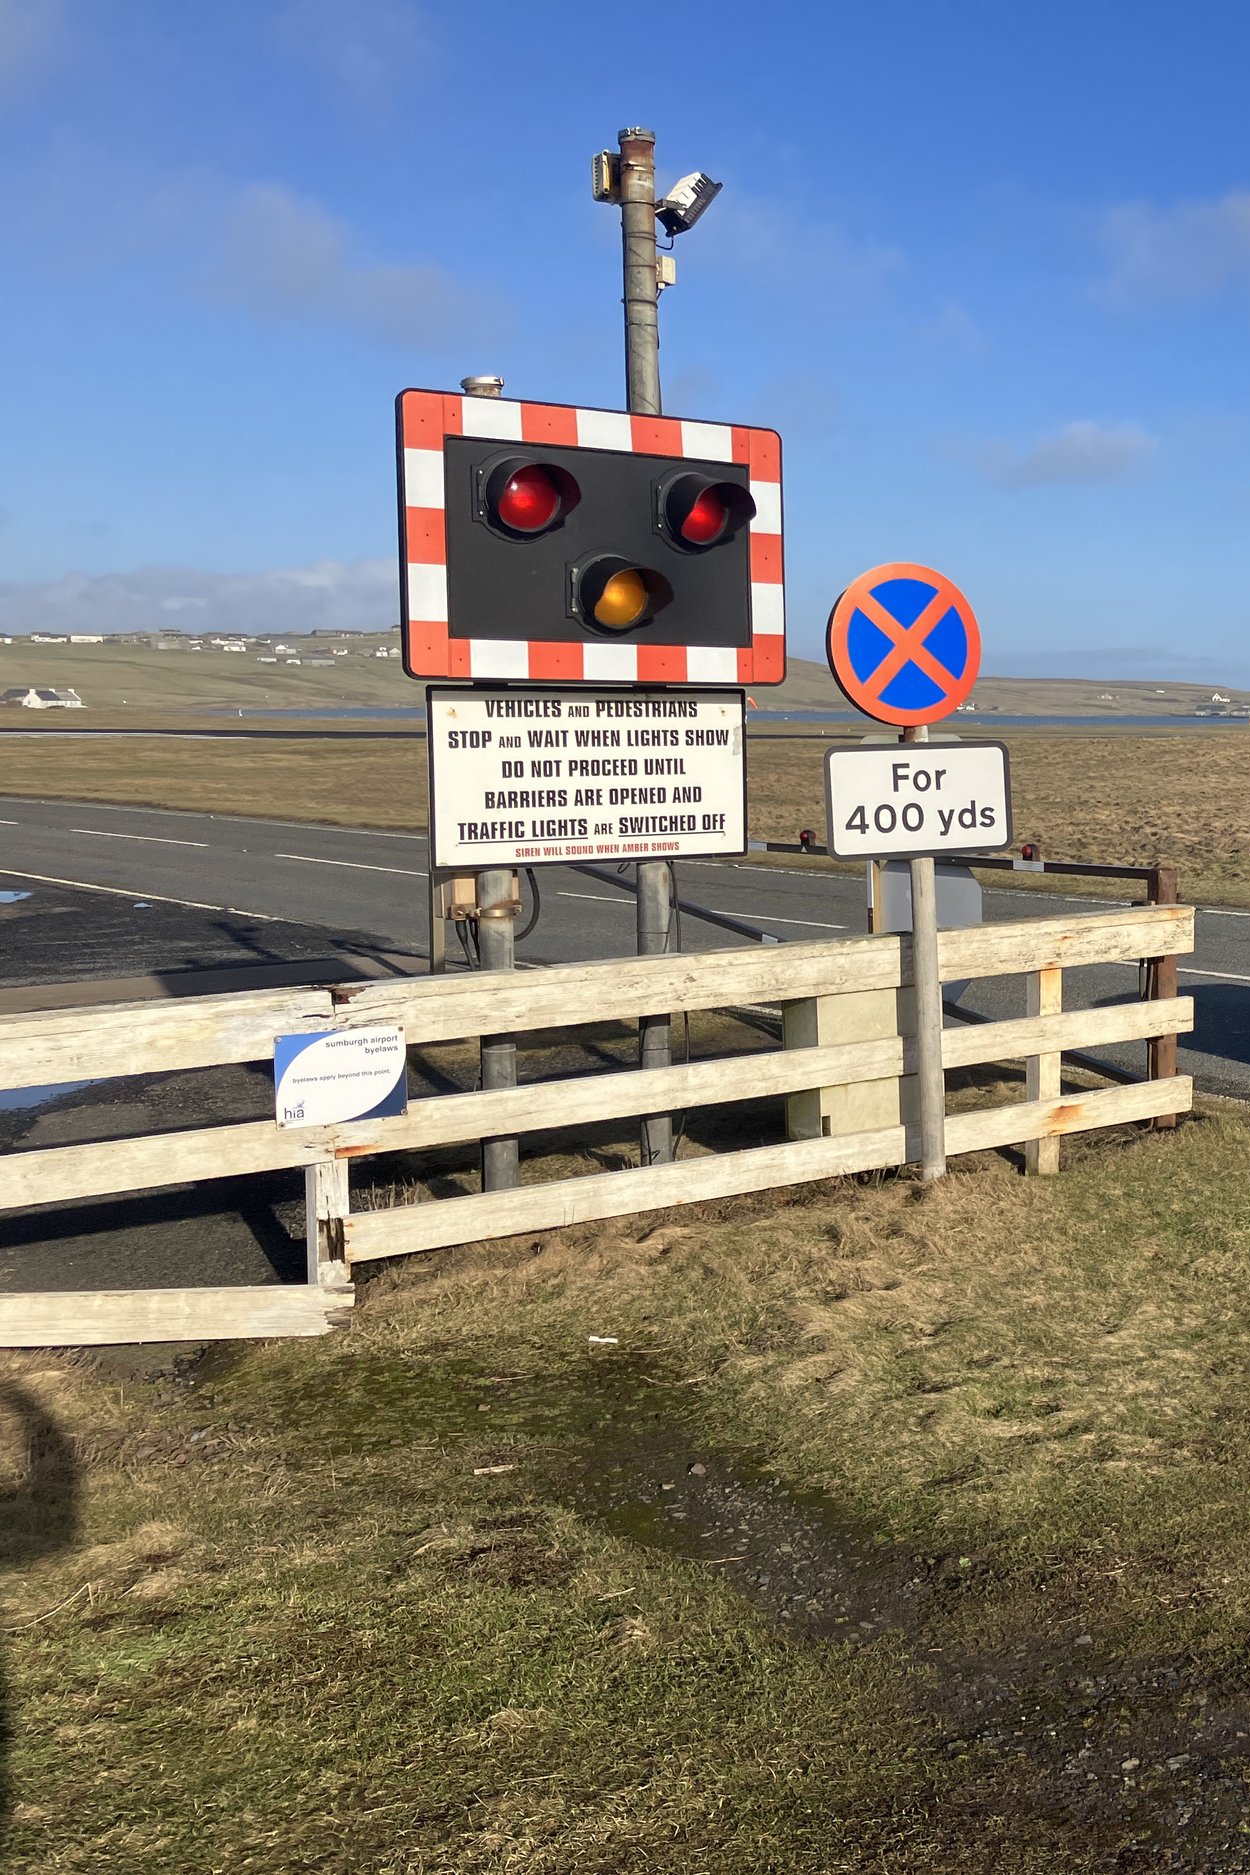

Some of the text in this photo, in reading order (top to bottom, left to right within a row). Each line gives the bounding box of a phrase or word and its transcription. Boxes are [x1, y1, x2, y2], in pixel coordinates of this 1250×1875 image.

[485, 700, 698, 718] VEHICLES AND PEDESTRIANS
[448, 729, 729, 749] STOP AND WAIT WHEN LIGHTS SHOW
[502, 758, 686, 778] DO NOT PROCEED UNTIL
[892, 763, 946, 792] For
[484, 786, 702, 809] BARRIERS ARE OPENED AND
[457, 813, 726, 840] TRAFFIC LIGHTS ARE SWITCHED OFF
[845, 800, 996, 836] 400 yds
[515, 842, 680, 858] SIREN WILL SOUND WHEN AMBER SHOWS
[326, 1035, 398, 1048] sumburgh airport
[365, 1046, 398, 1055] byelaws
[284, 1107, 304, 1119] hia
